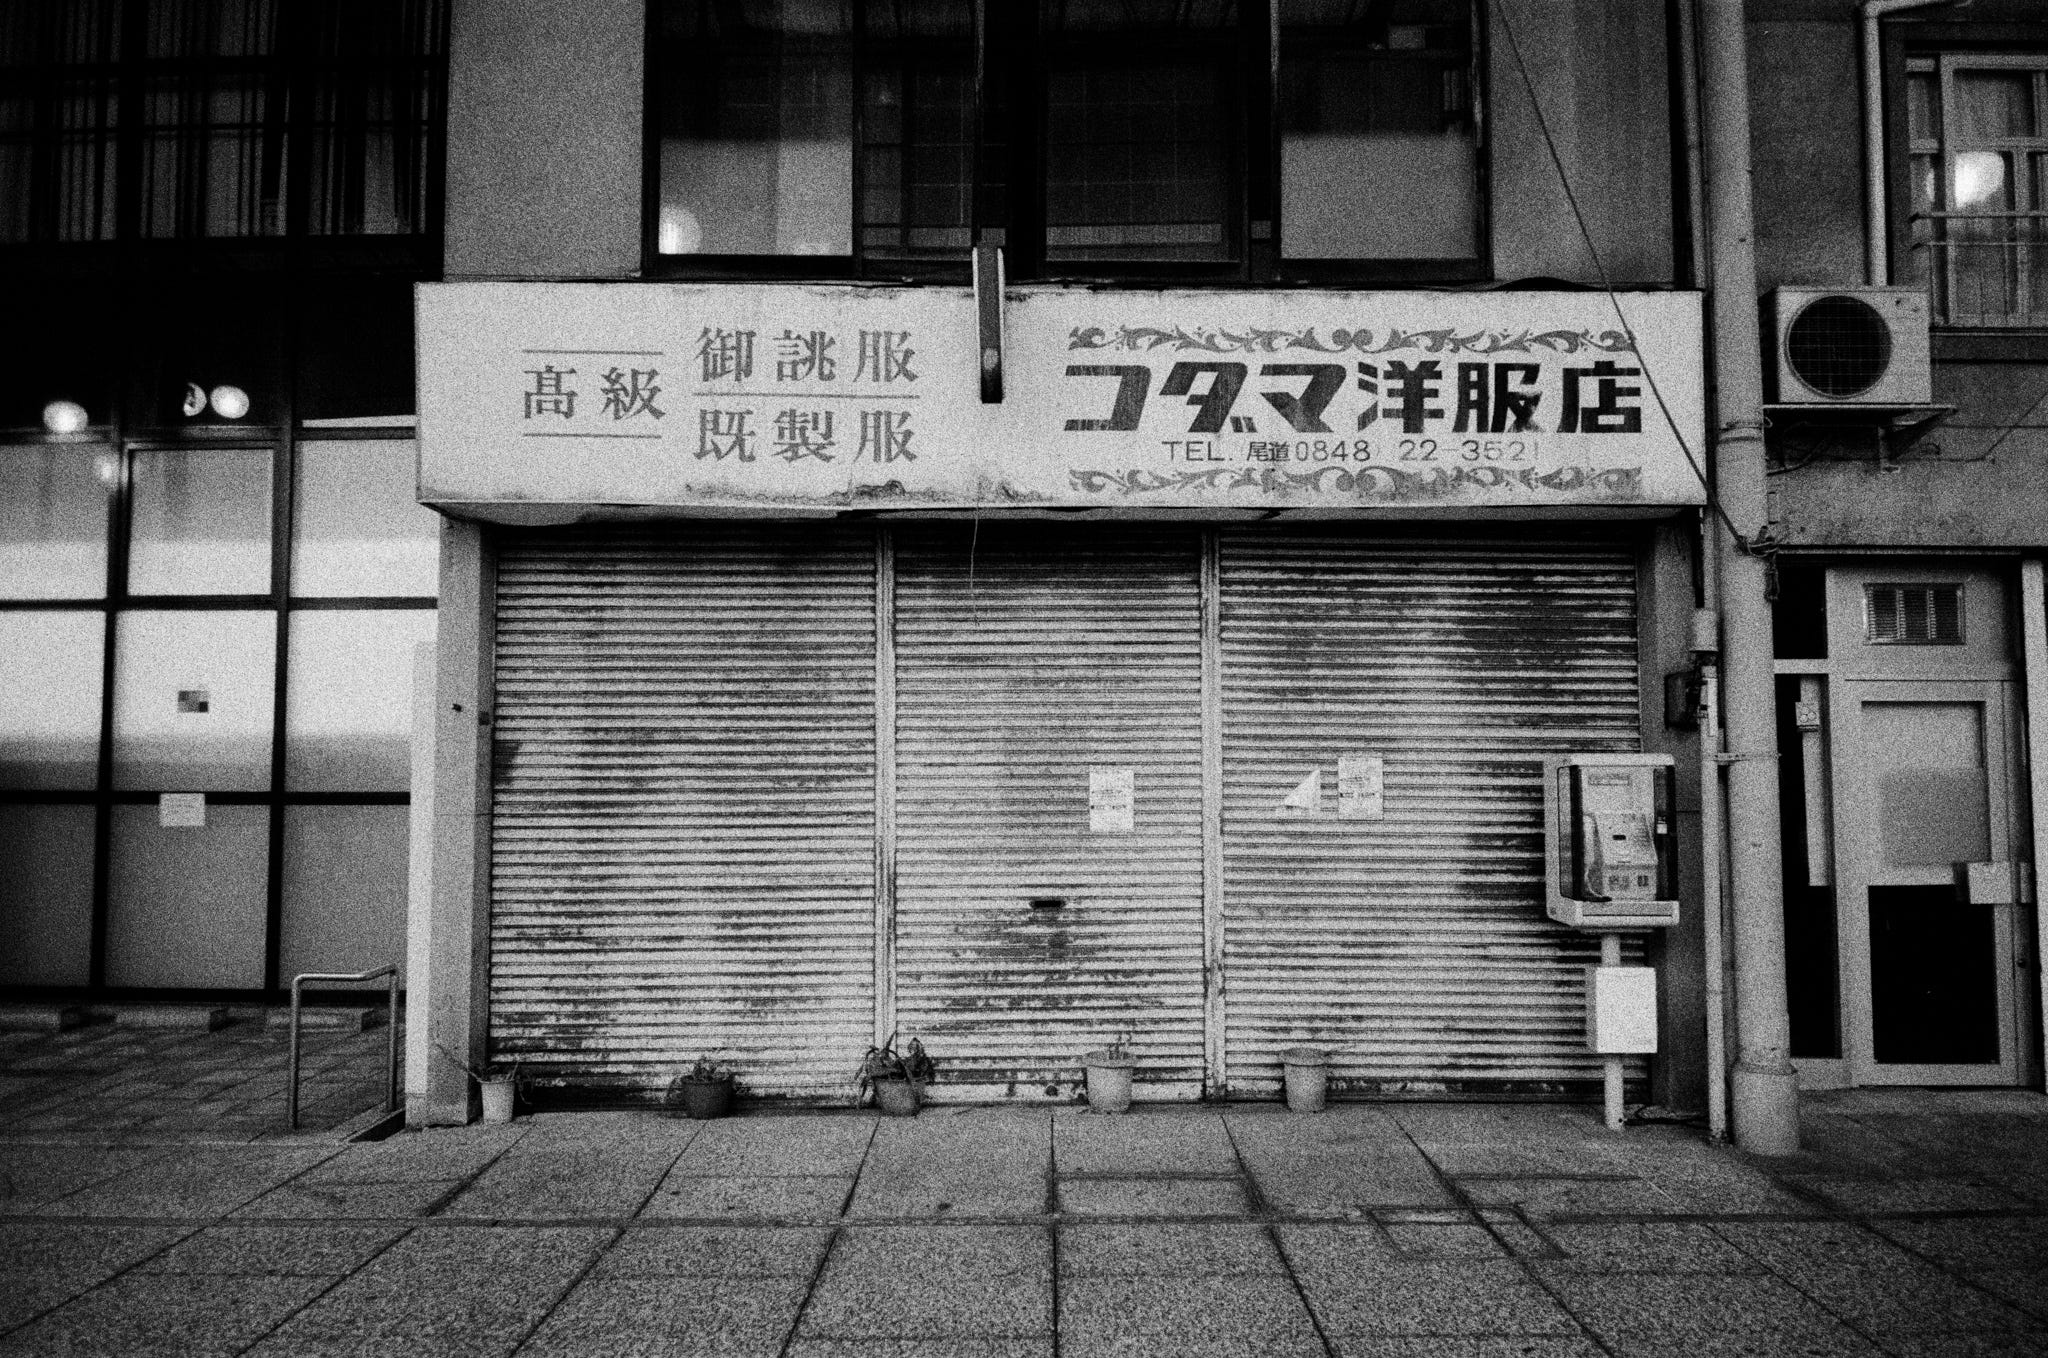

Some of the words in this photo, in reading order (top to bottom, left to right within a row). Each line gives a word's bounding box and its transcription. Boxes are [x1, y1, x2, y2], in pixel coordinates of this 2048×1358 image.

[694, 327, 919, 383] 御誂服
[1064, 361, 1642, 433] コダマ洋服店
[693, 409, 918, 463] 既製服
[1161, 440, 1233, 462] TEL.
